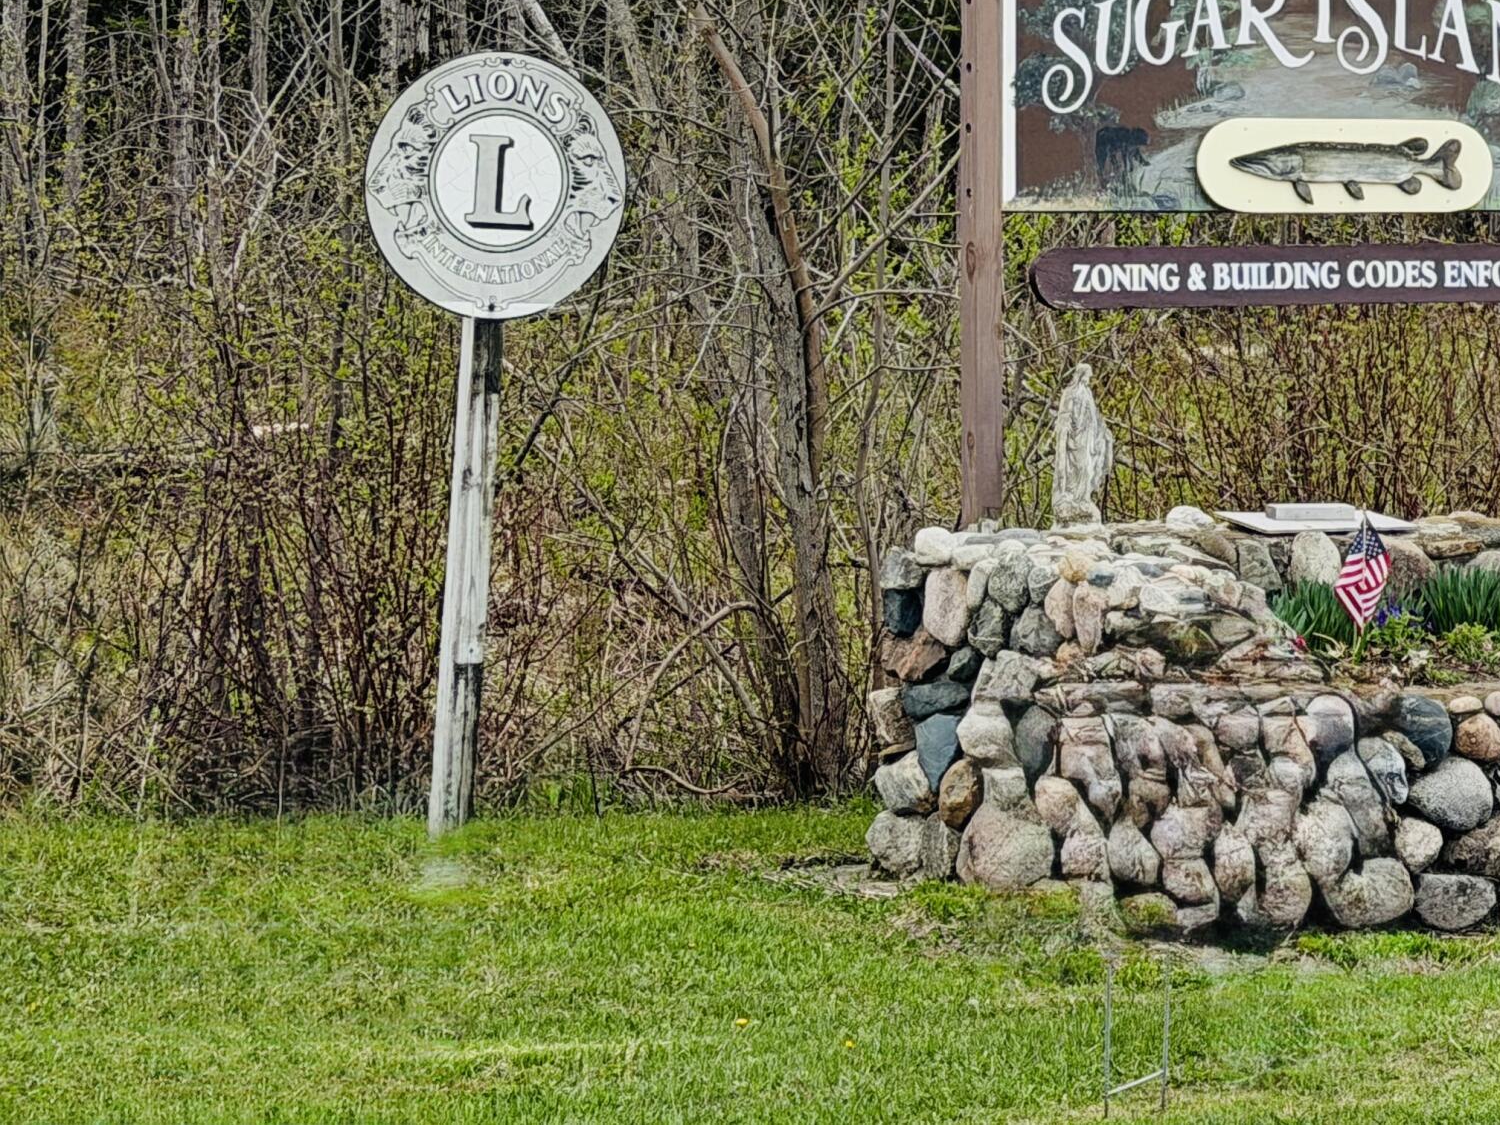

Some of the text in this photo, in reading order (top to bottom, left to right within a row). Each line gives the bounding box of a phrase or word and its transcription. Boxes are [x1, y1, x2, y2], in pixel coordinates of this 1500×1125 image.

[439, 70, 571, 124] LIONS
[464, 133, 534, 231] L
[421, 234, 570, 285] INTERNATIONAL
[1073, 262, 1180, 293] ZONING
[1187, 262, 1207, 292] &
[1212, 261, 1341, 291] BUILDING
[1347, 260, 1438, 289] CODES
